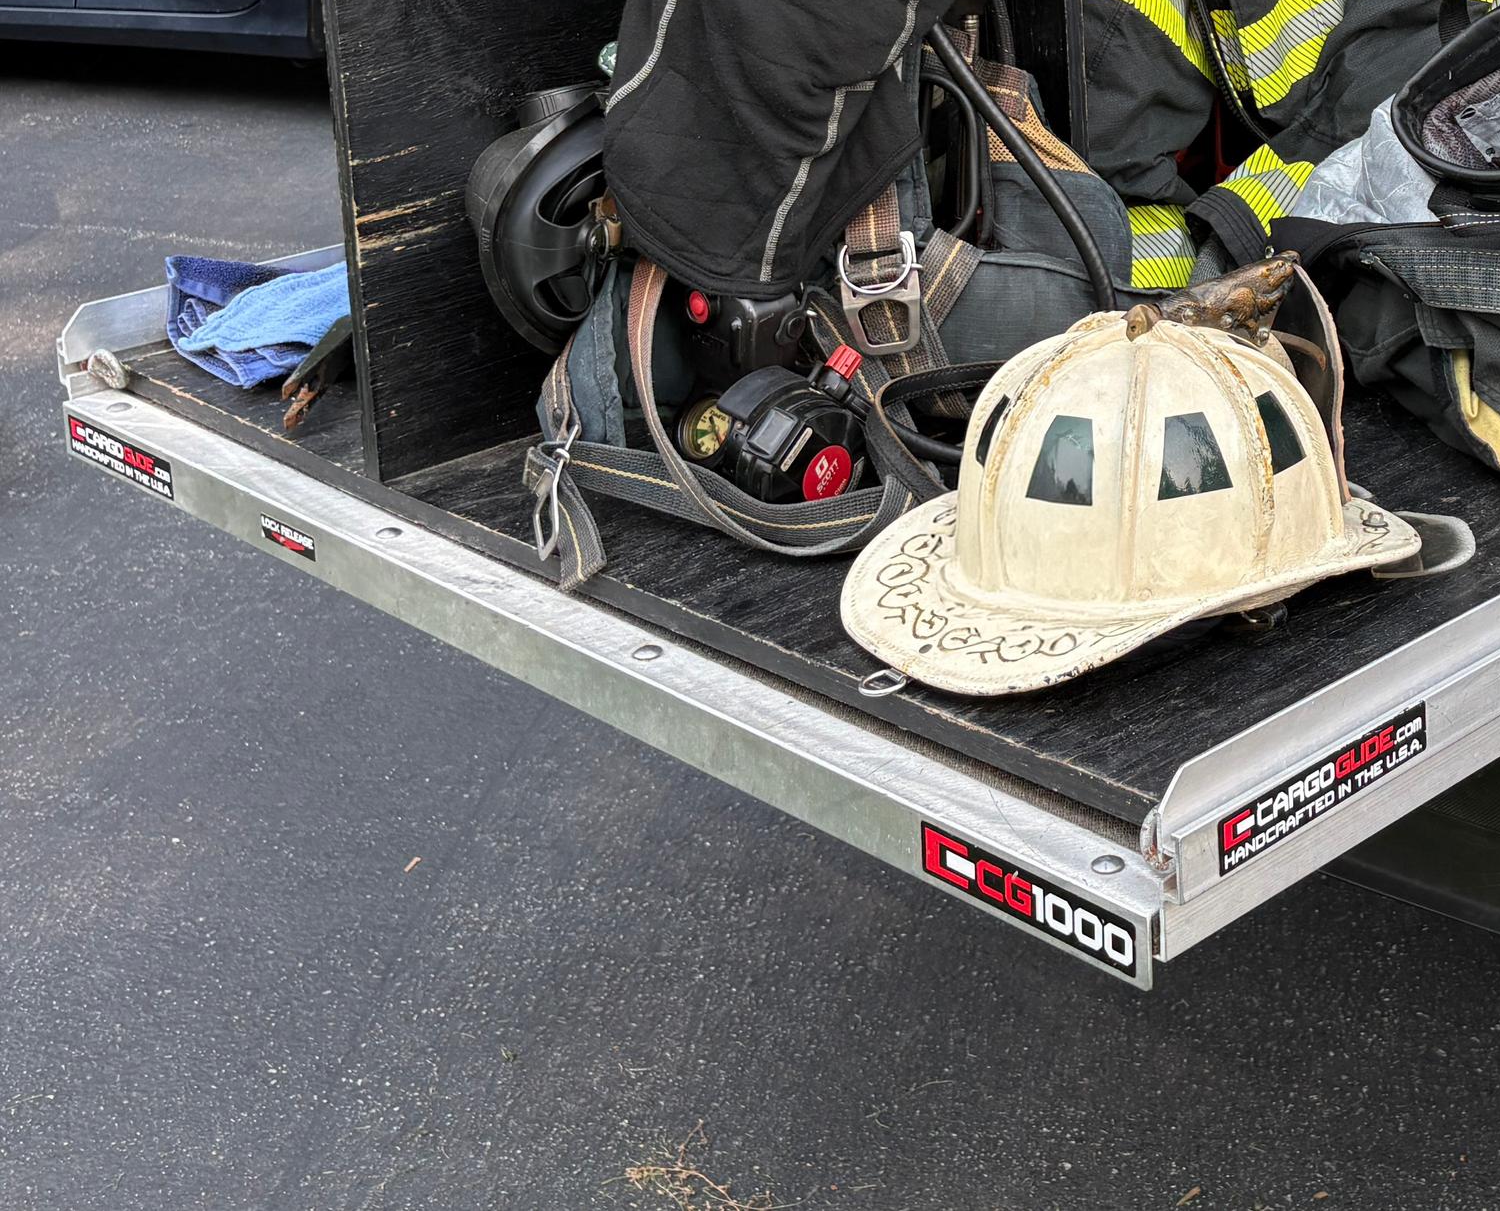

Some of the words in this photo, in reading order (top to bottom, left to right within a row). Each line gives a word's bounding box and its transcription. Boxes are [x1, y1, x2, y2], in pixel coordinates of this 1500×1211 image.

[817, 458, 838, 493] SCOTT
[1224, 790, 1336, 871] HANDCRAFTED
[1338, 779, 1352, 800] IN
[1354, 759, 1384, 788] THE
[1386, 738, 1423, 768] U.S.A.
[976, 858, 1134, 968] CG1000
